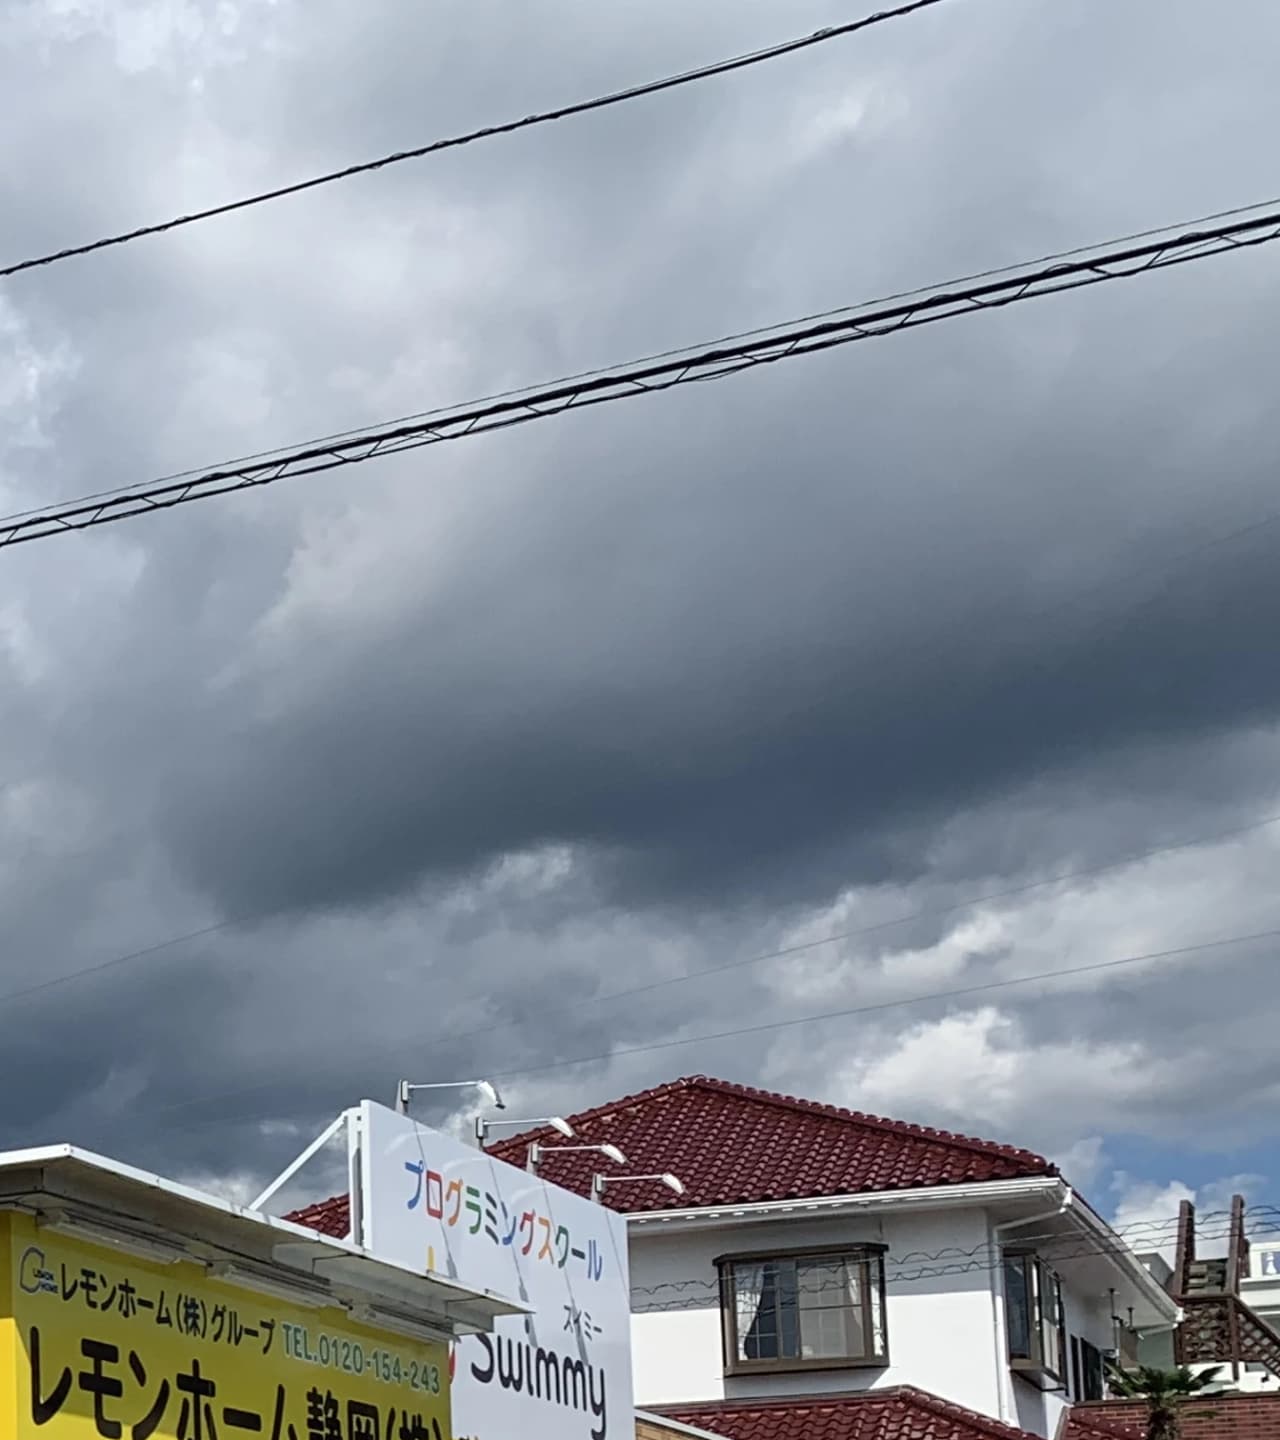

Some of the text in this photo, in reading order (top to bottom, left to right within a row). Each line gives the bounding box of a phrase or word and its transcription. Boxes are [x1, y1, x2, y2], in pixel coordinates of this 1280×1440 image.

[405, 1159, 603, 1282] プログラミングスクール
[61, 1263, 441, 1396] レモンホーム(株)グループ TEL.0120-154-243
[563, 1305, 603, 1341] スイミー
